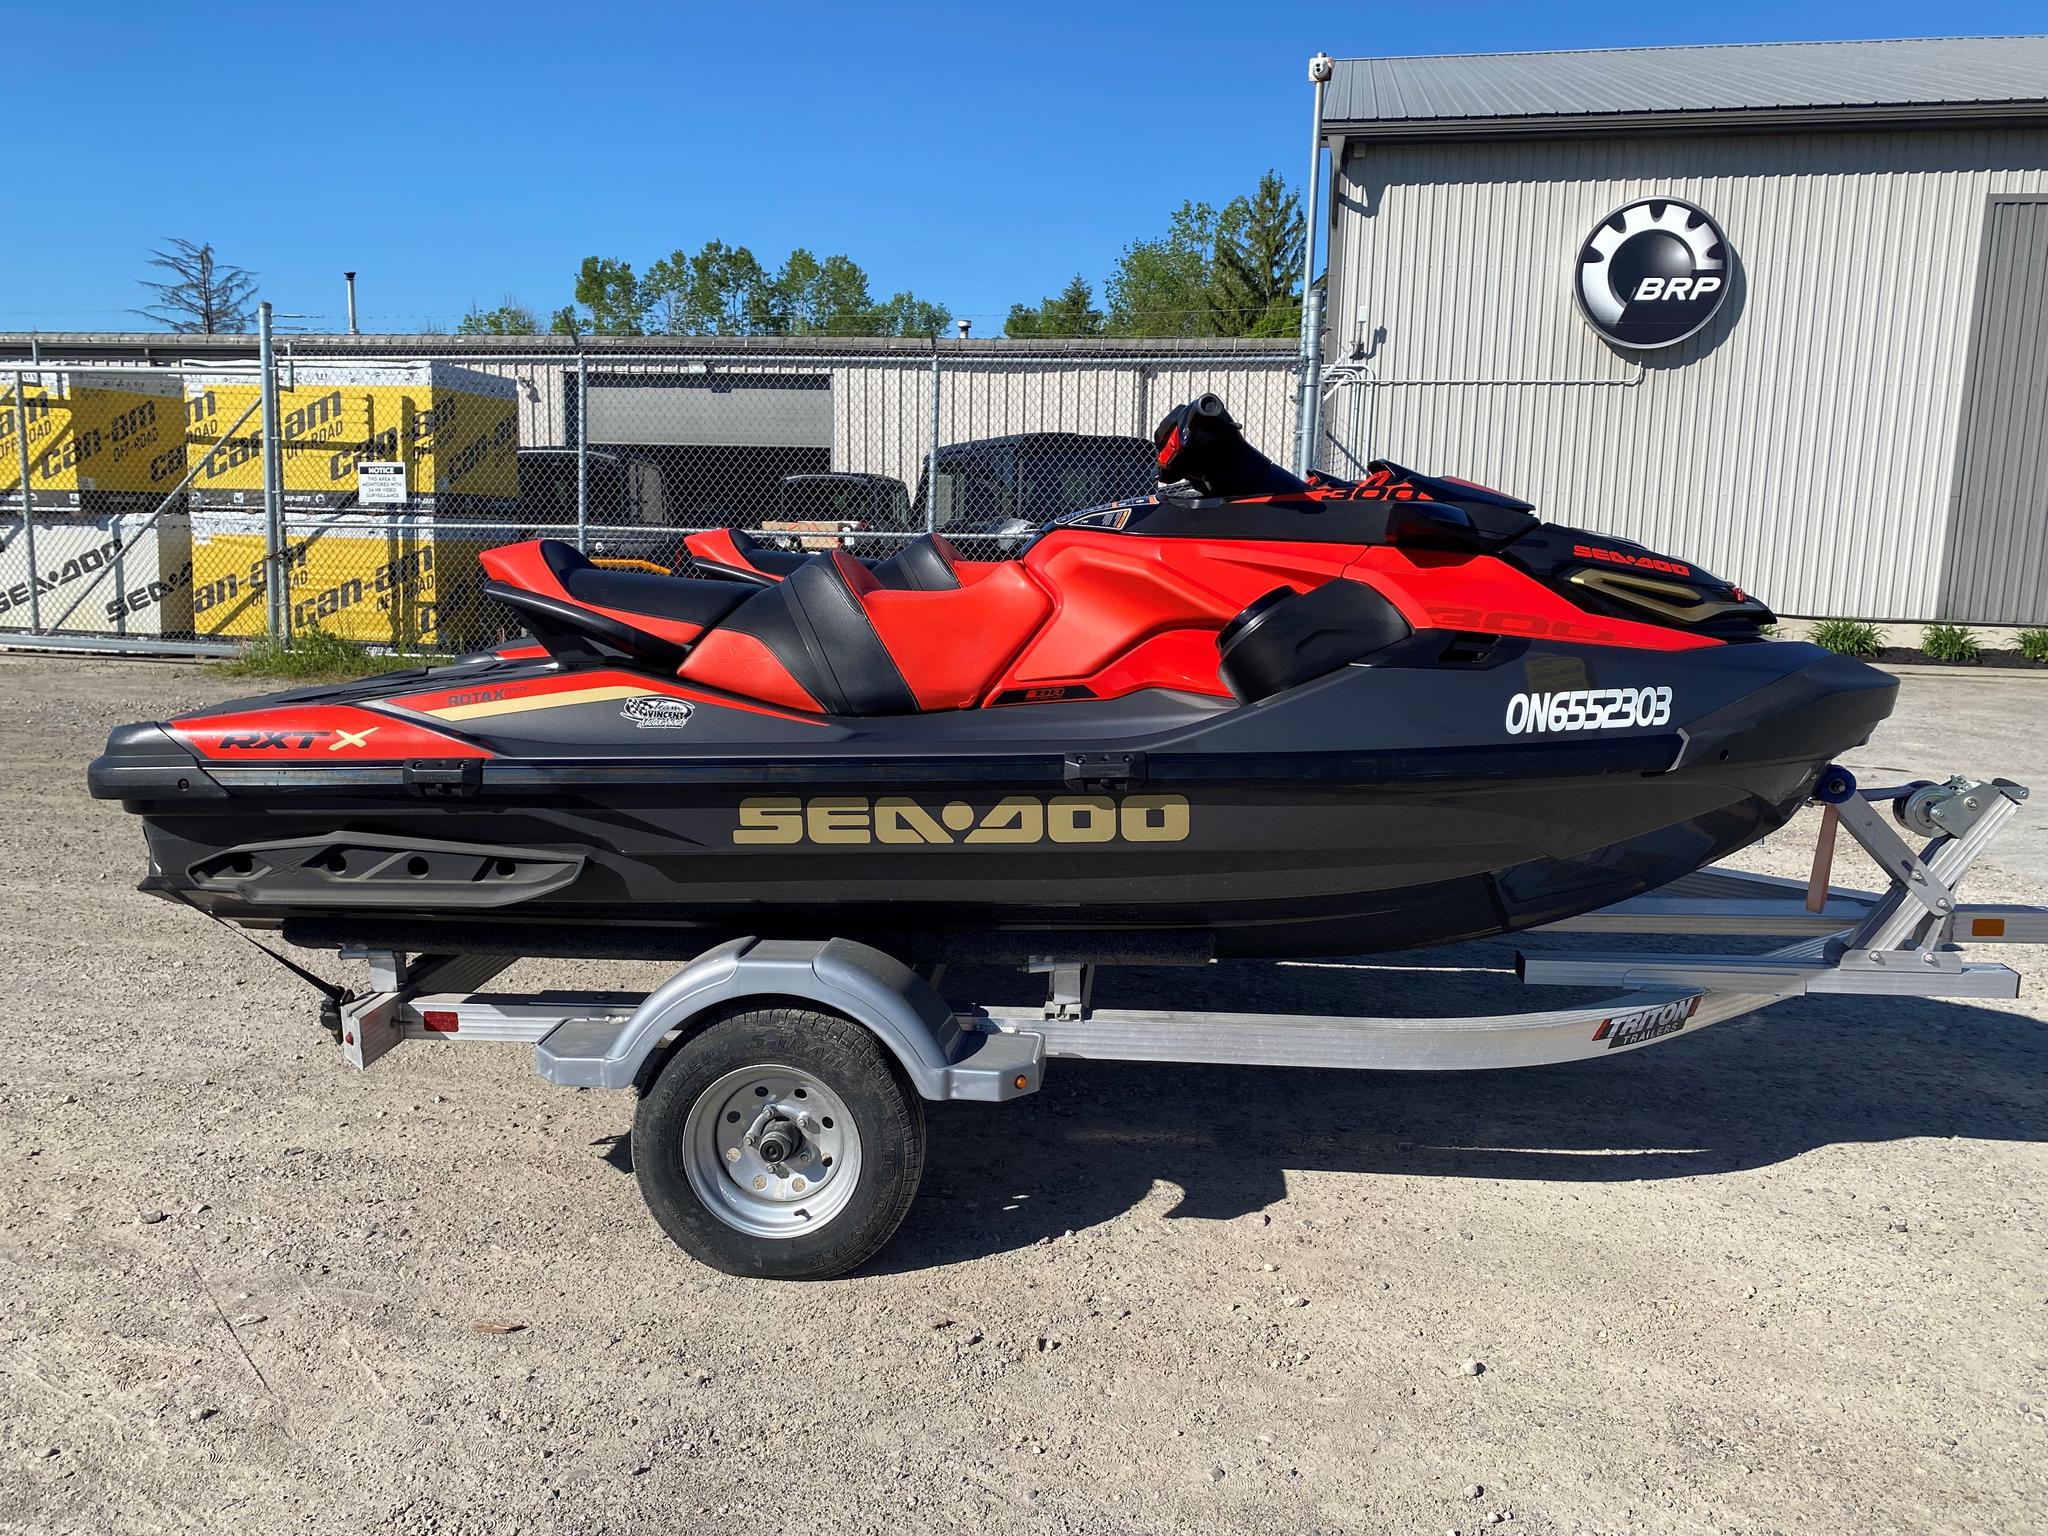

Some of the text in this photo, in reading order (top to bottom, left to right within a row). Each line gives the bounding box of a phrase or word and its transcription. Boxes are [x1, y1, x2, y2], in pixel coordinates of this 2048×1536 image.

[1633, 276, 1721, 301] BRP
[448, 688, 506, 706] ROTAX
[648, 710, 685, 719] VINCENT
[1505, 686, 1673, 735] ON6552303
[218, 726, 380, 752] RXT X
[1607, 998, 1695, 1038] TRITON
[1623, 1022, 1678, 1045] TRAILERS
